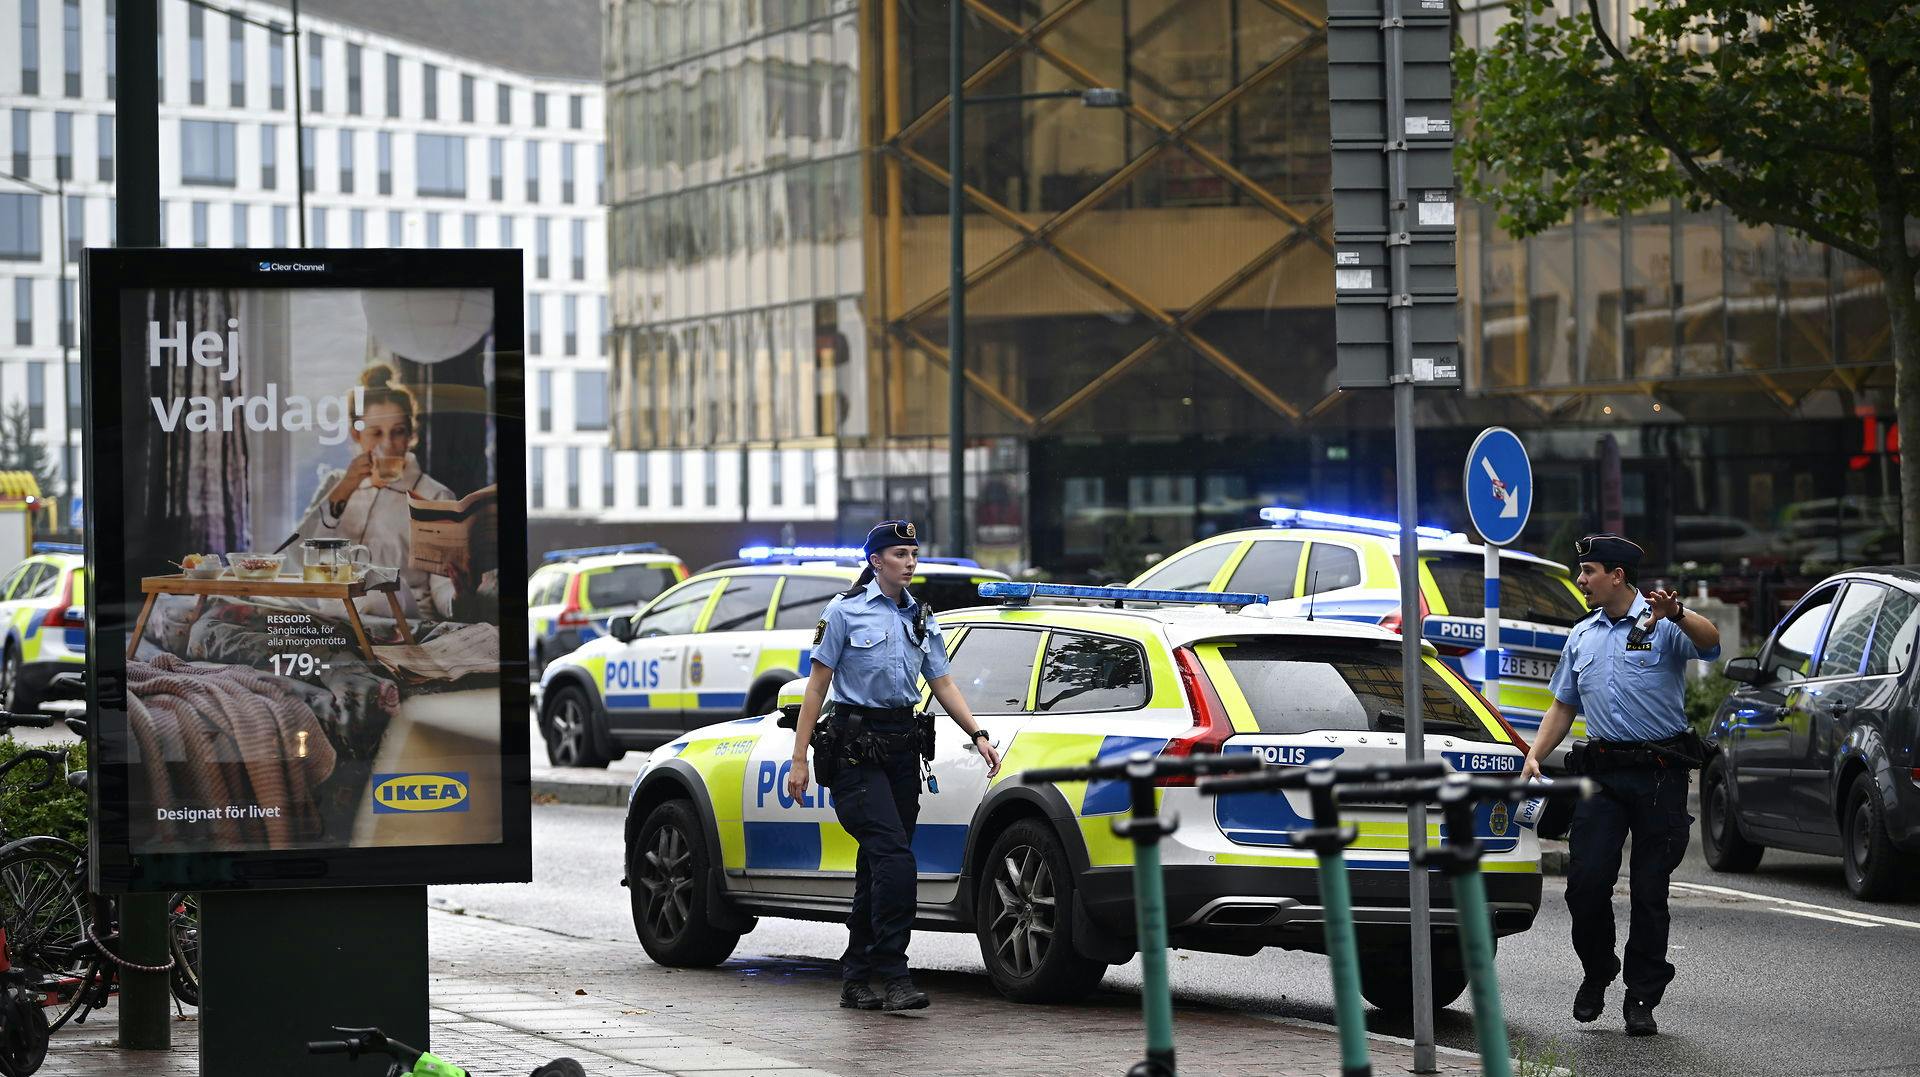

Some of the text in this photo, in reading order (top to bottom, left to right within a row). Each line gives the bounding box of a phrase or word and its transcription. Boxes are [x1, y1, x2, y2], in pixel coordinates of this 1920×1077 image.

[271, 262, 325, 271] Clear Channel
[149, 318, 240, 382] Hej
[150, 382, 366, 446] vardag!
[267, 614, 311, 624] RESGODS
[321, 624, 335, 634] för
[1440, 622, 1484, 639] POLIS
[267, 636, 347, 648] alla morgontrötta
[269, 652, 331, 677] 179:-
[1501, 656, 1526, 674] ZBE
[605, 660, 660, 689] POLIS
[714, 739, 753, 757] 65-1150
[1251, 746, 1306, 763] POLIS
[1459, 754, 1515, 771] 1 65-1150
[382, 784, 462, 801] IKEA
[157, 805, 281, 823] Designat för livet
